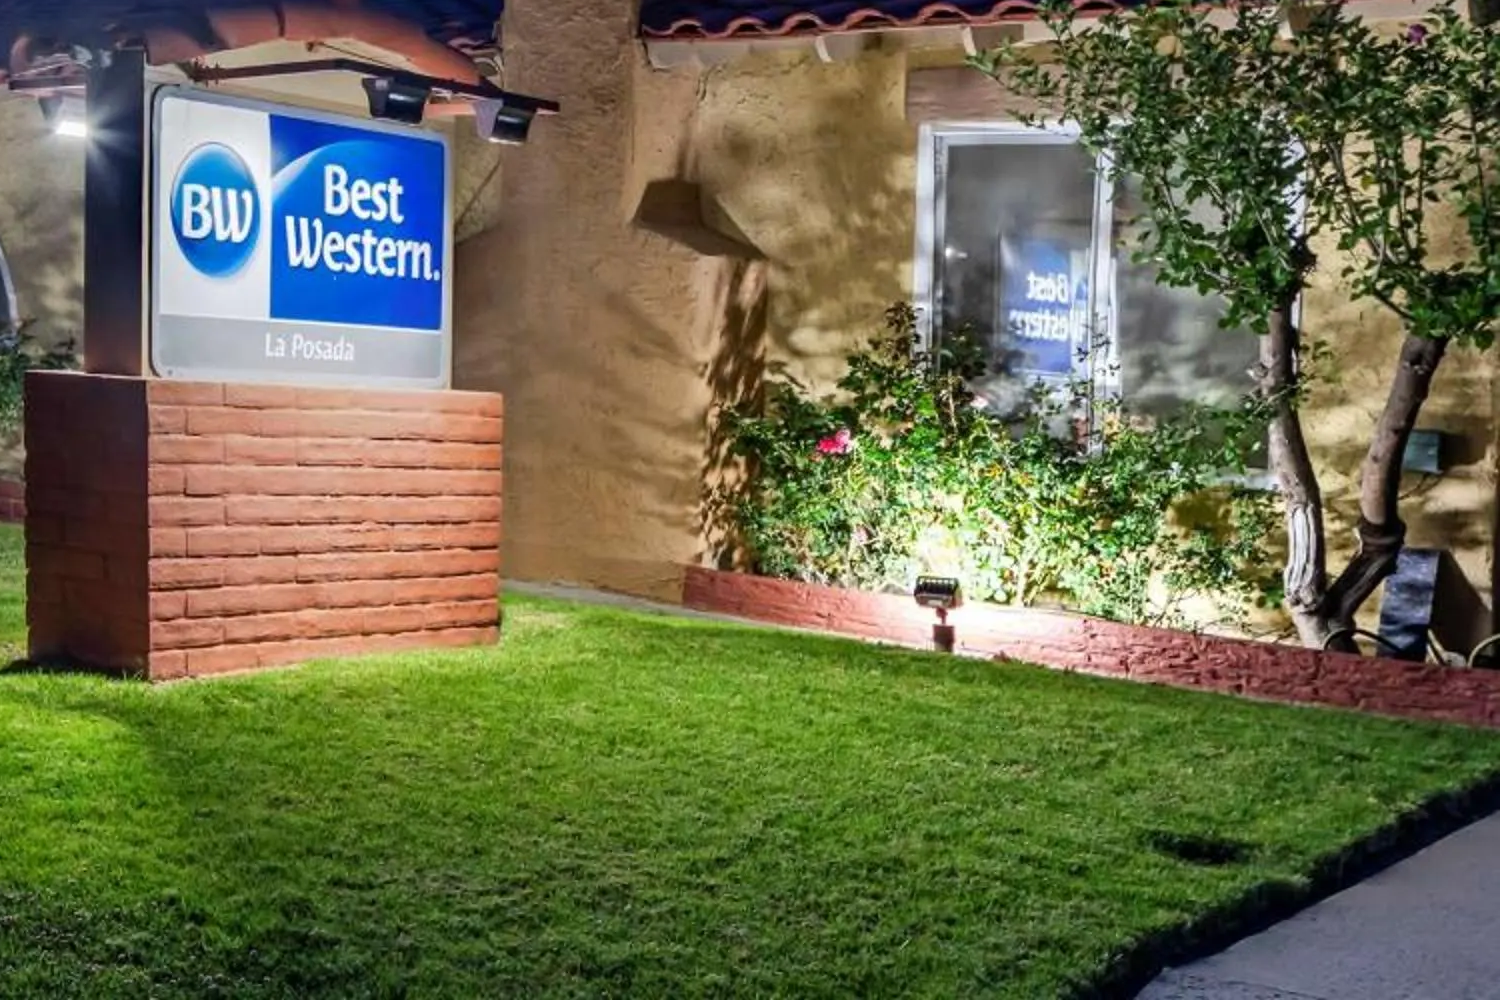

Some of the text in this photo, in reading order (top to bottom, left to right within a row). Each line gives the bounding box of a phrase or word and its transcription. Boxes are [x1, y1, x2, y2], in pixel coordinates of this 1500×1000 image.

[181, 183, 252, 244] BW
[324, 165, 404, 224] Best
[265, 332, 355, 361] La Posada
